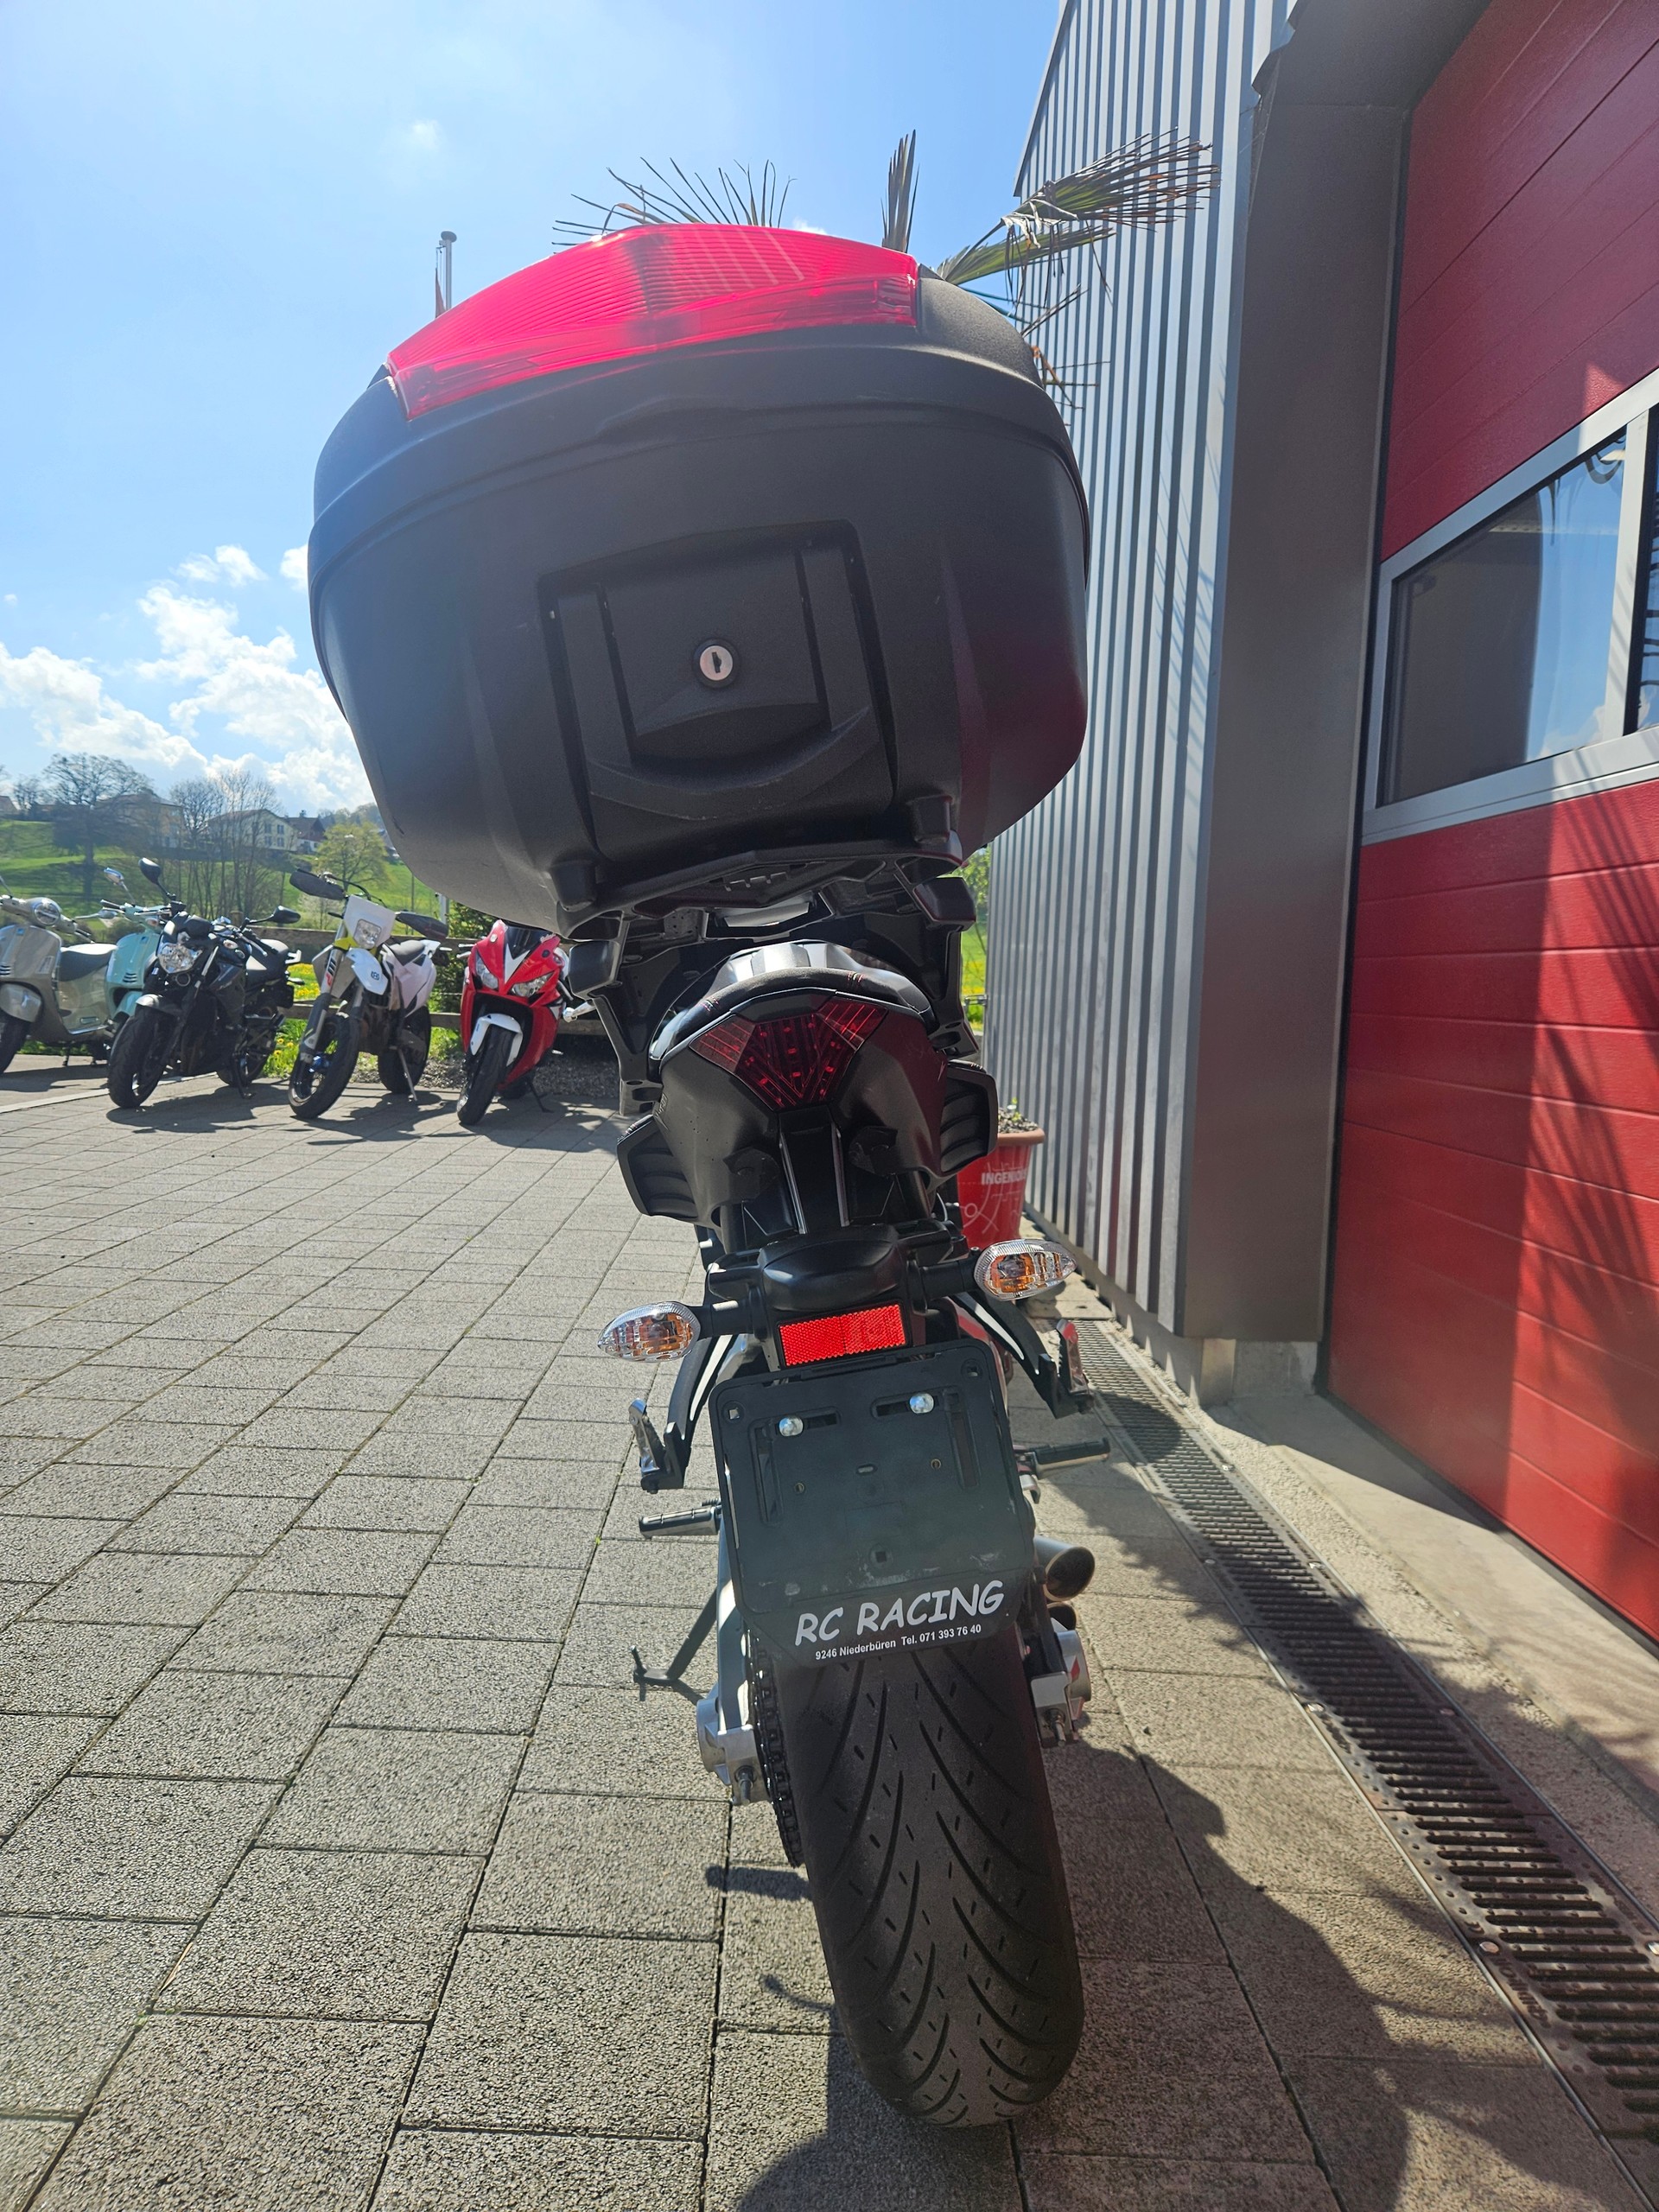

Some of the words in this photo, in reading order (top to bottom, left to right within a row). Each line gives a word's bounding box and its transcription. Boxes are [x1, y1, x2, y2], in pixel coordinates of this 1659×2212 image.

[794, 1606, 844, 1646] RC
[856, 1580, 1005, 1636] RACING
[815, 1649, 837, 1661] 9246
[839, 1640, 897, 1656] Niederbüren
[900, 1635, 918, 1646] Tel.
[918, 1631, 936, 1643] 071
[938, 1628, 955, 1640] 393
[957, 1625, 969, 1637] 76
[969, 1624, 982, 1634] 40
